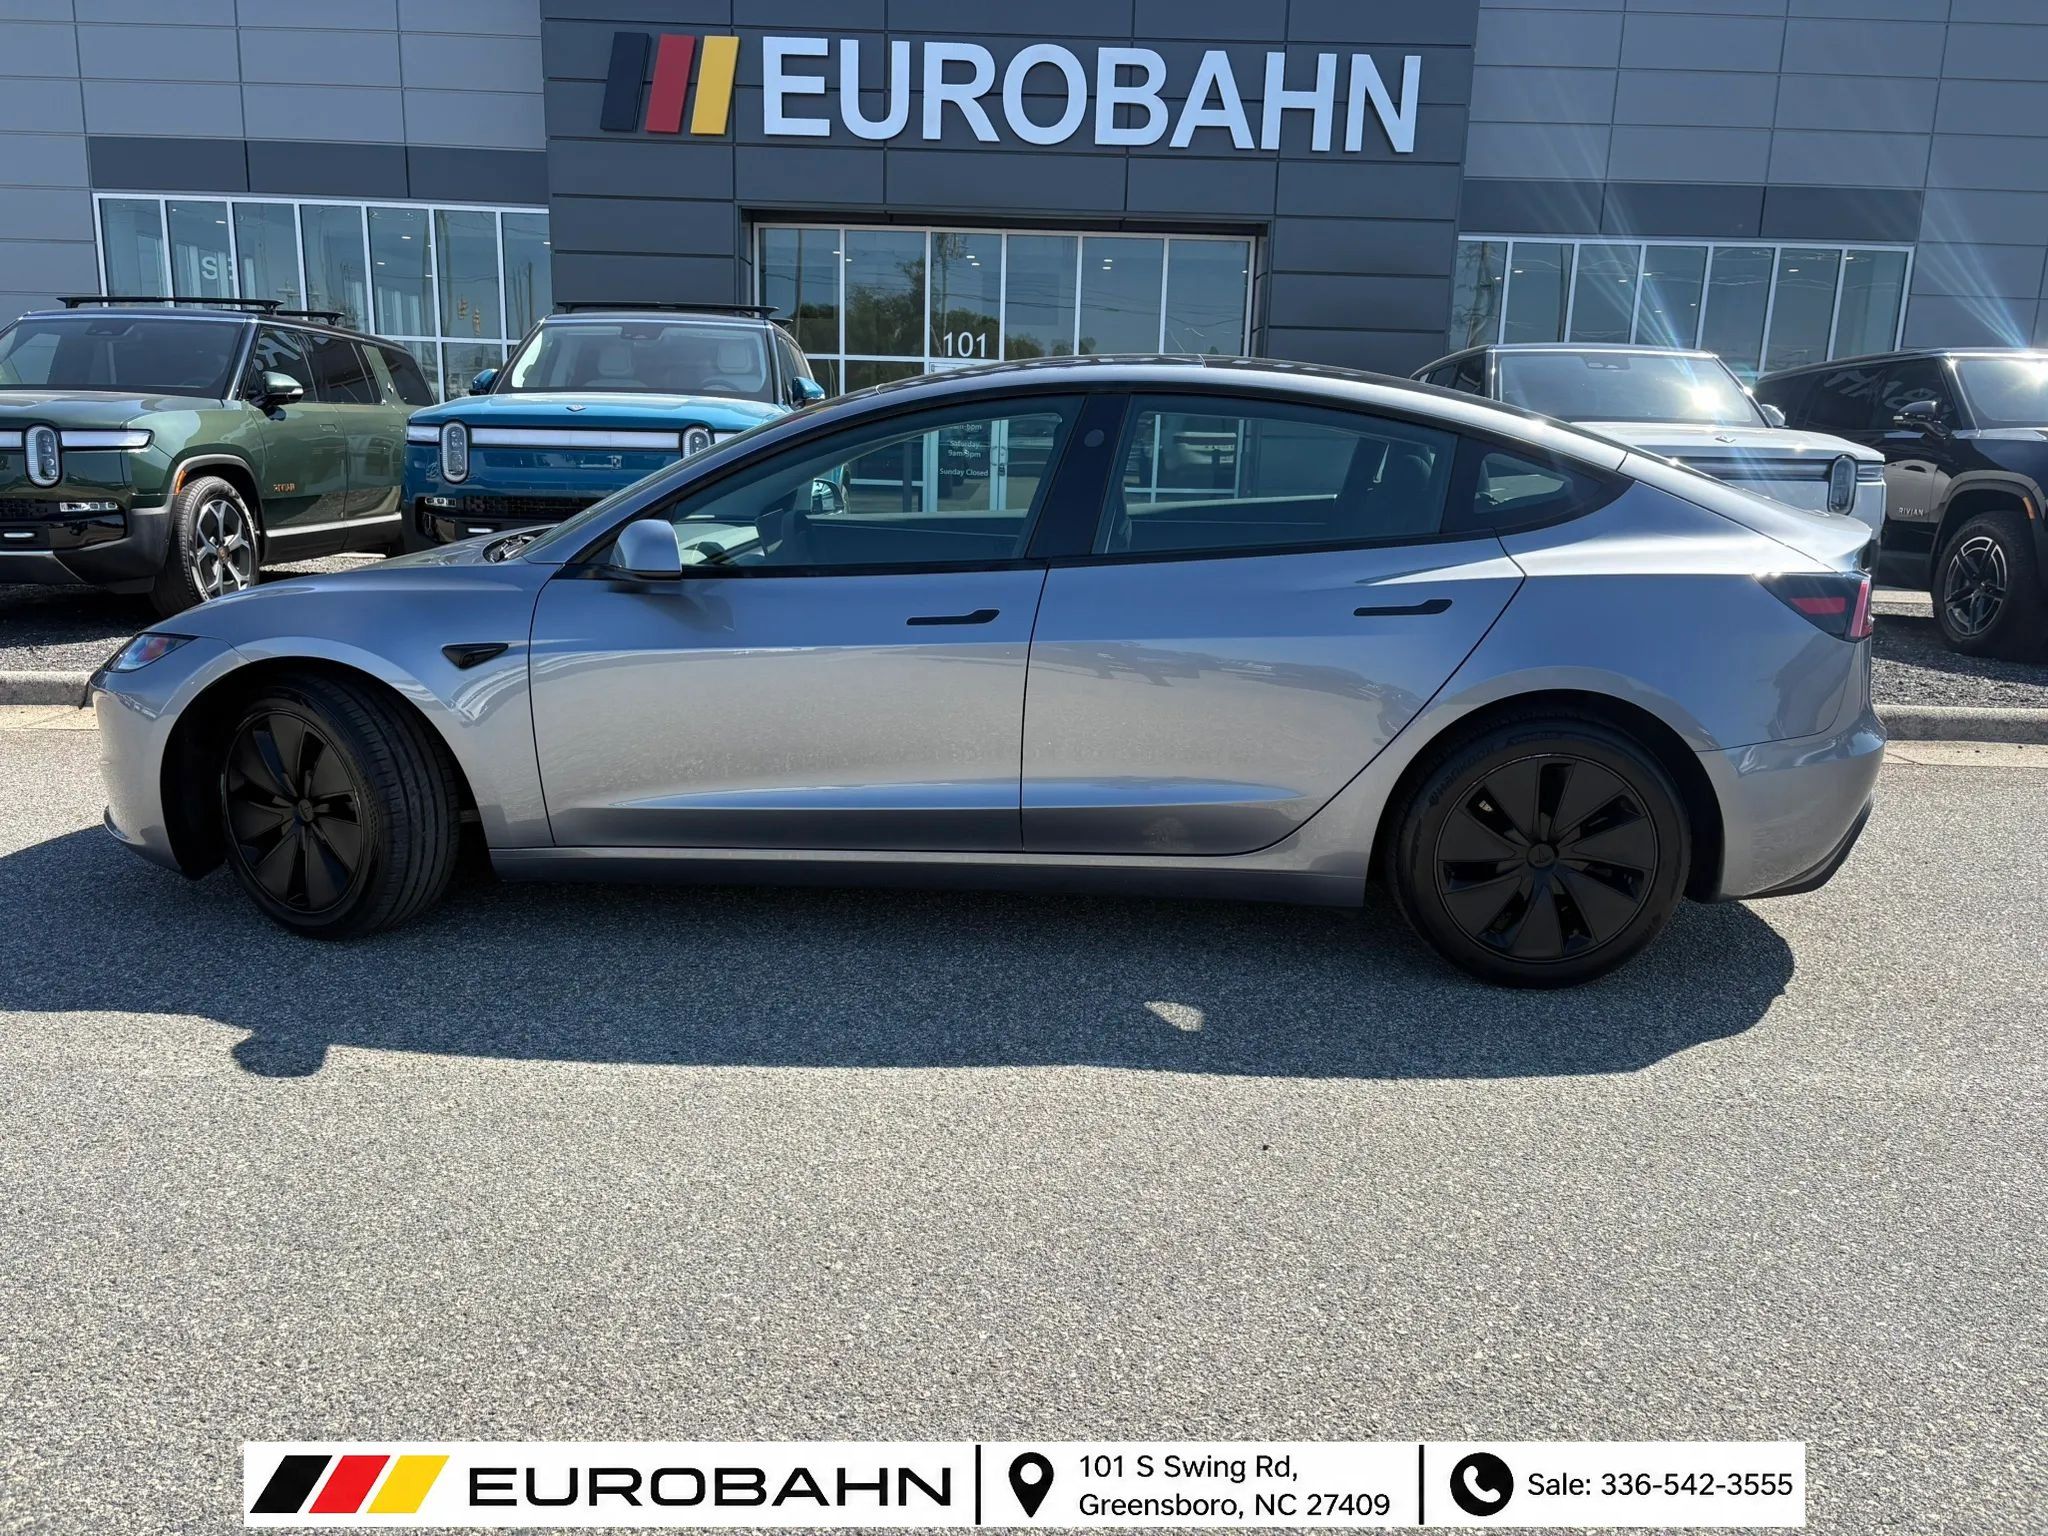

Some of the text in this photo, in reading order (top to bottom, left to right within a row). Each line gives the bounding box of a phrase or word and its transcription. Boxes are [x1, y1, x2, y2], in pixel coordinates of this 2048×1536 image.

[763, 36, 1421, 153] EUROBAHN
[943, 331, 987, 358] 101
[950, 440, 980, 450] Saturday
[939, 468, 989, 477] Sunday Closed
[1898, 506, 1924, 516] RIVIAN
